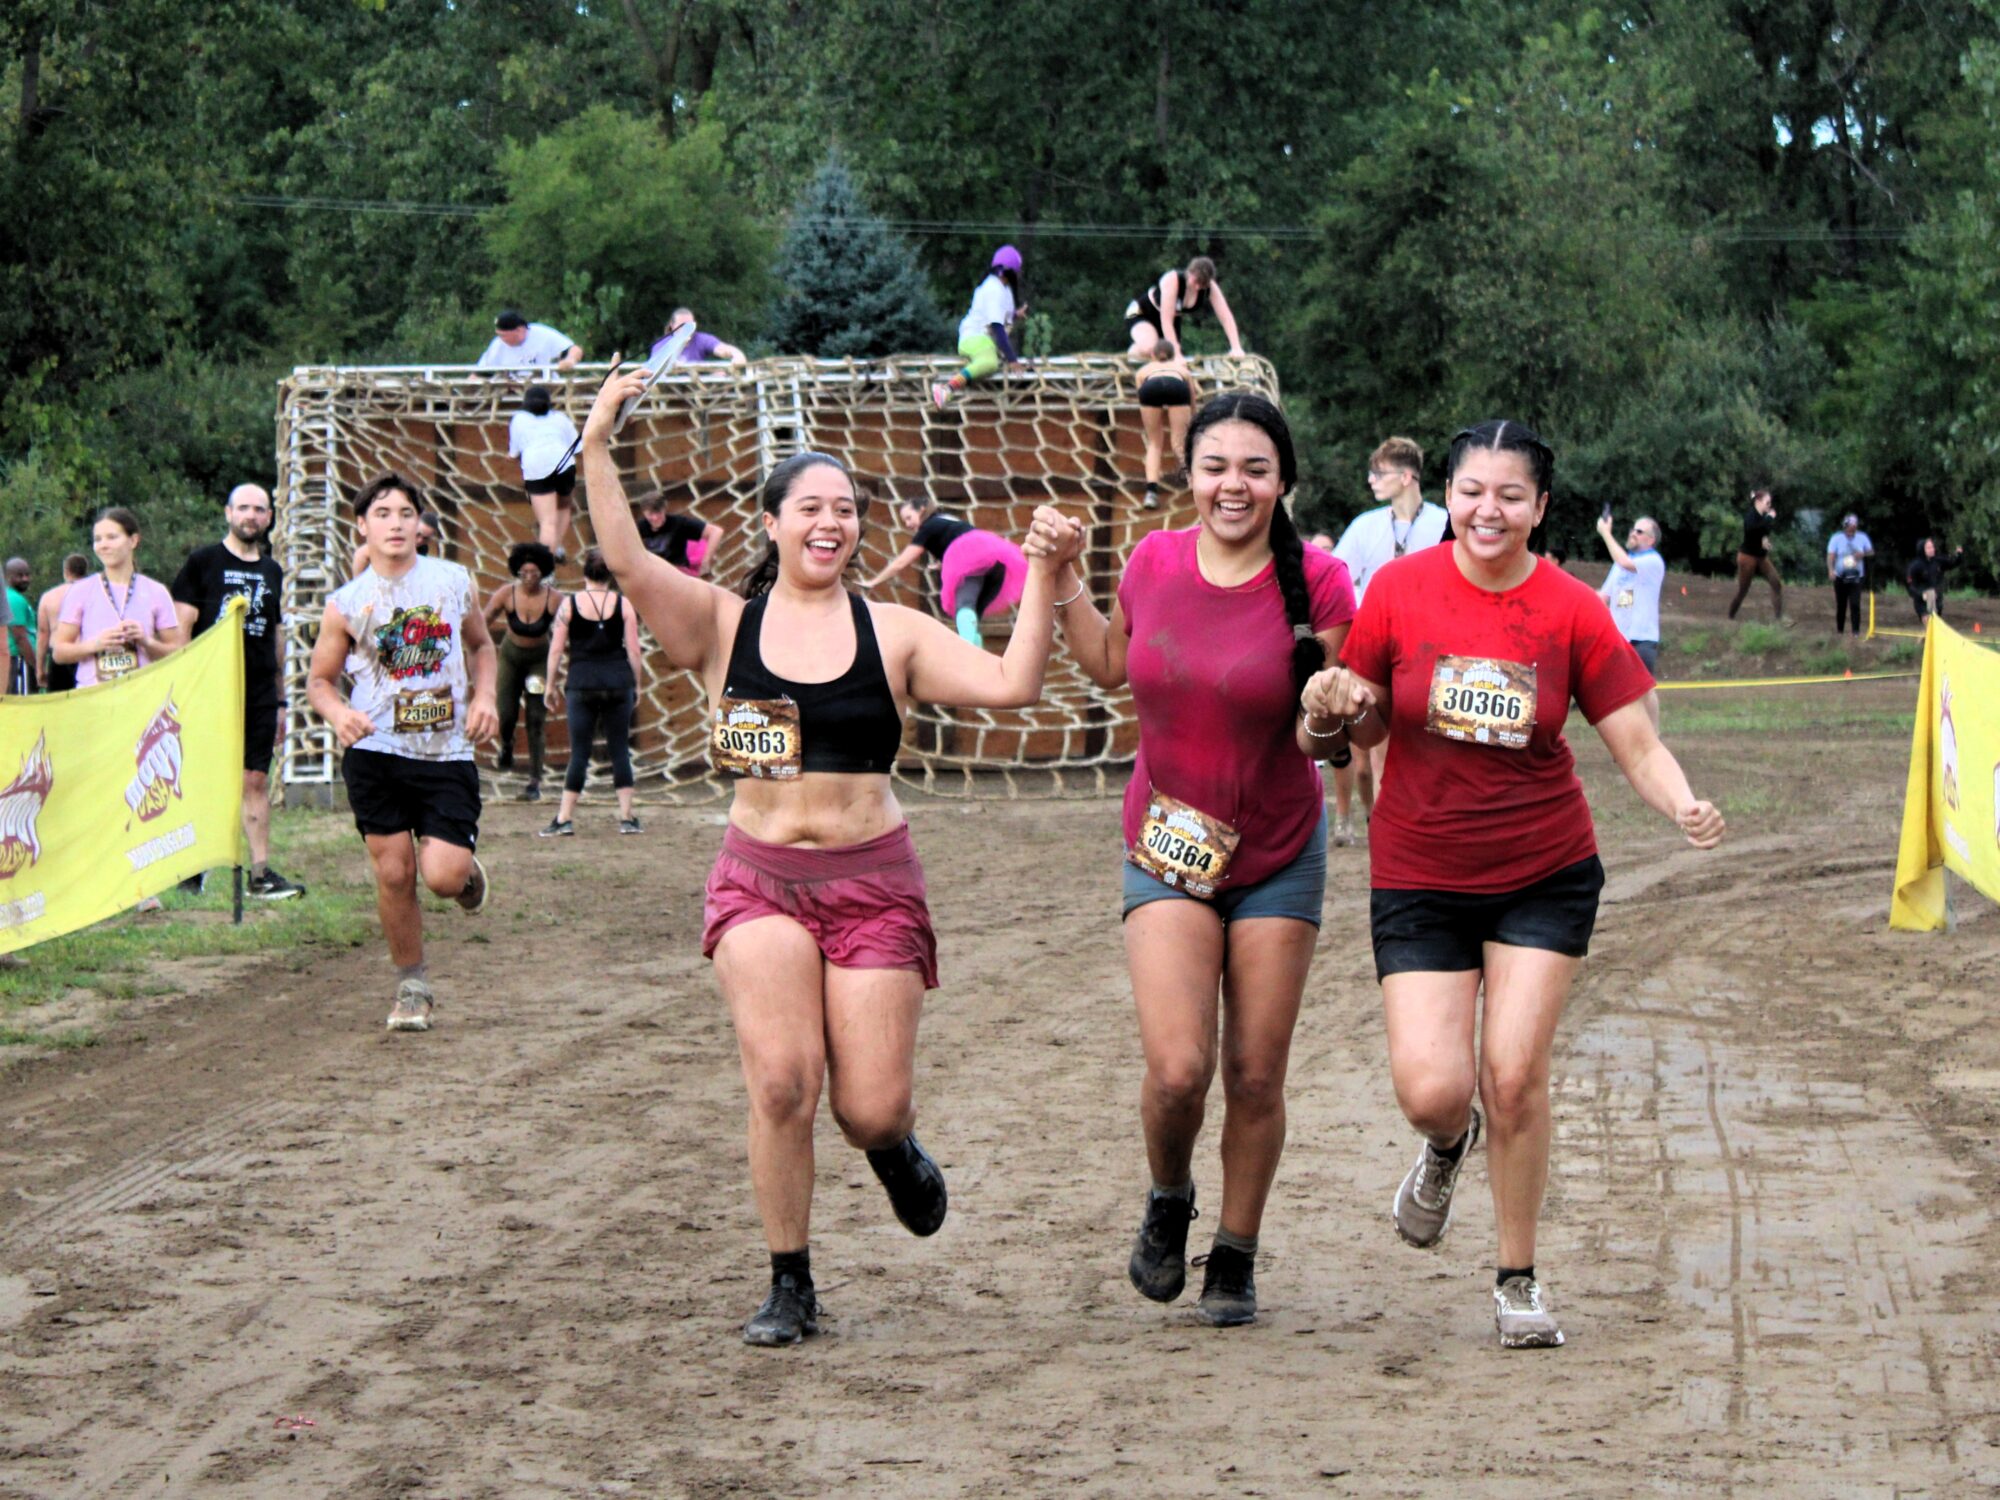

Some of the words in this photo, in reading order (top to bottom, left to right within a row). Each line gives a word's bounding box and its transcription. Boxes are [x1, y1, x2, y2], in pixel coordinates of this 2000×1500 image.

[403, 704, 447, 721] 23506
[1443, 687, 1522, 720] 30366
[728, 711, 769, 728] MUDDY
[720, 728, 786, 754] 30363
[1148, 825, 1213, 872] 30364
